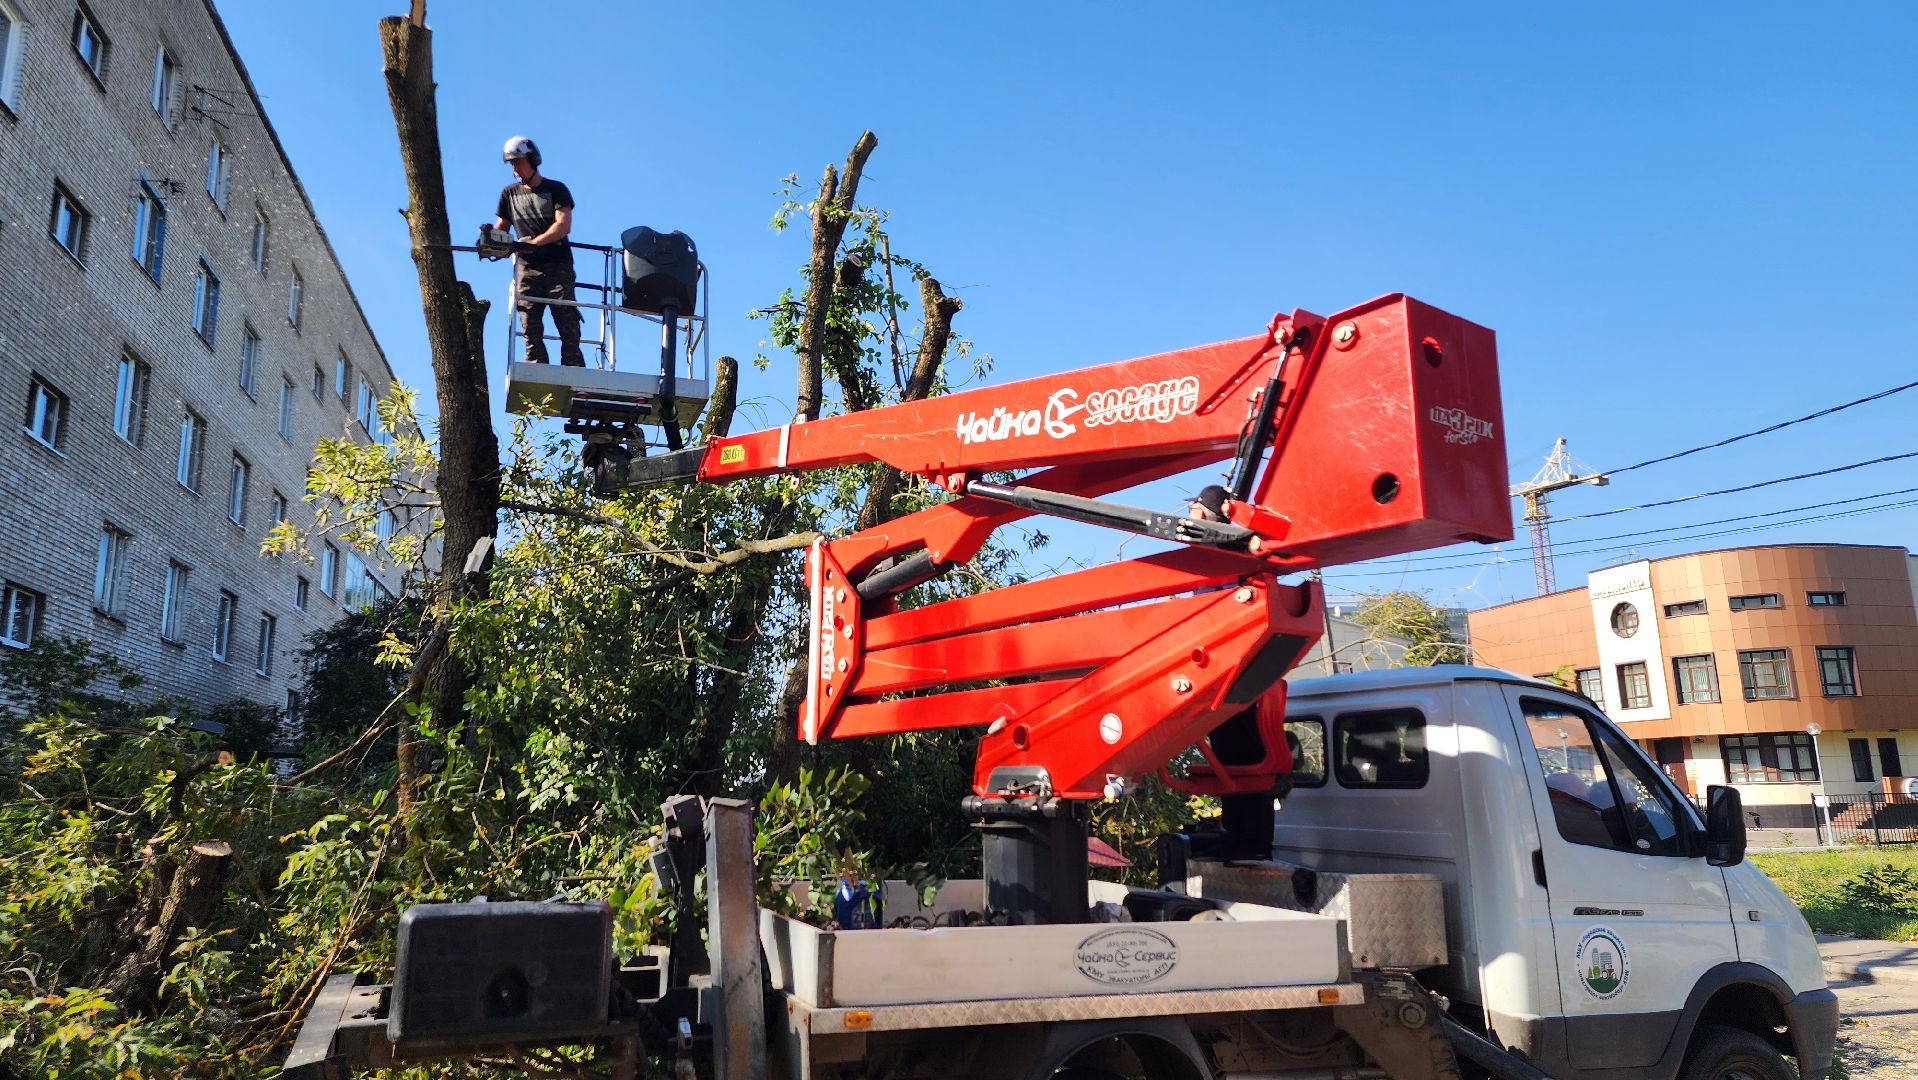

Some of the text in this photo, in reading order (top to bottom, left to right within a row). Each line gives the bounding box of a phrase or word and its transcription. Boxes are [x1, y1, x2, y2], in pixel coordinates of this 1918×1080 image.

[956, 376, 1199, 444] Чайка socage
[1077, 950, 1176, 963] Чайка Сервис
[1154, 962, 1168, 975] АГП
